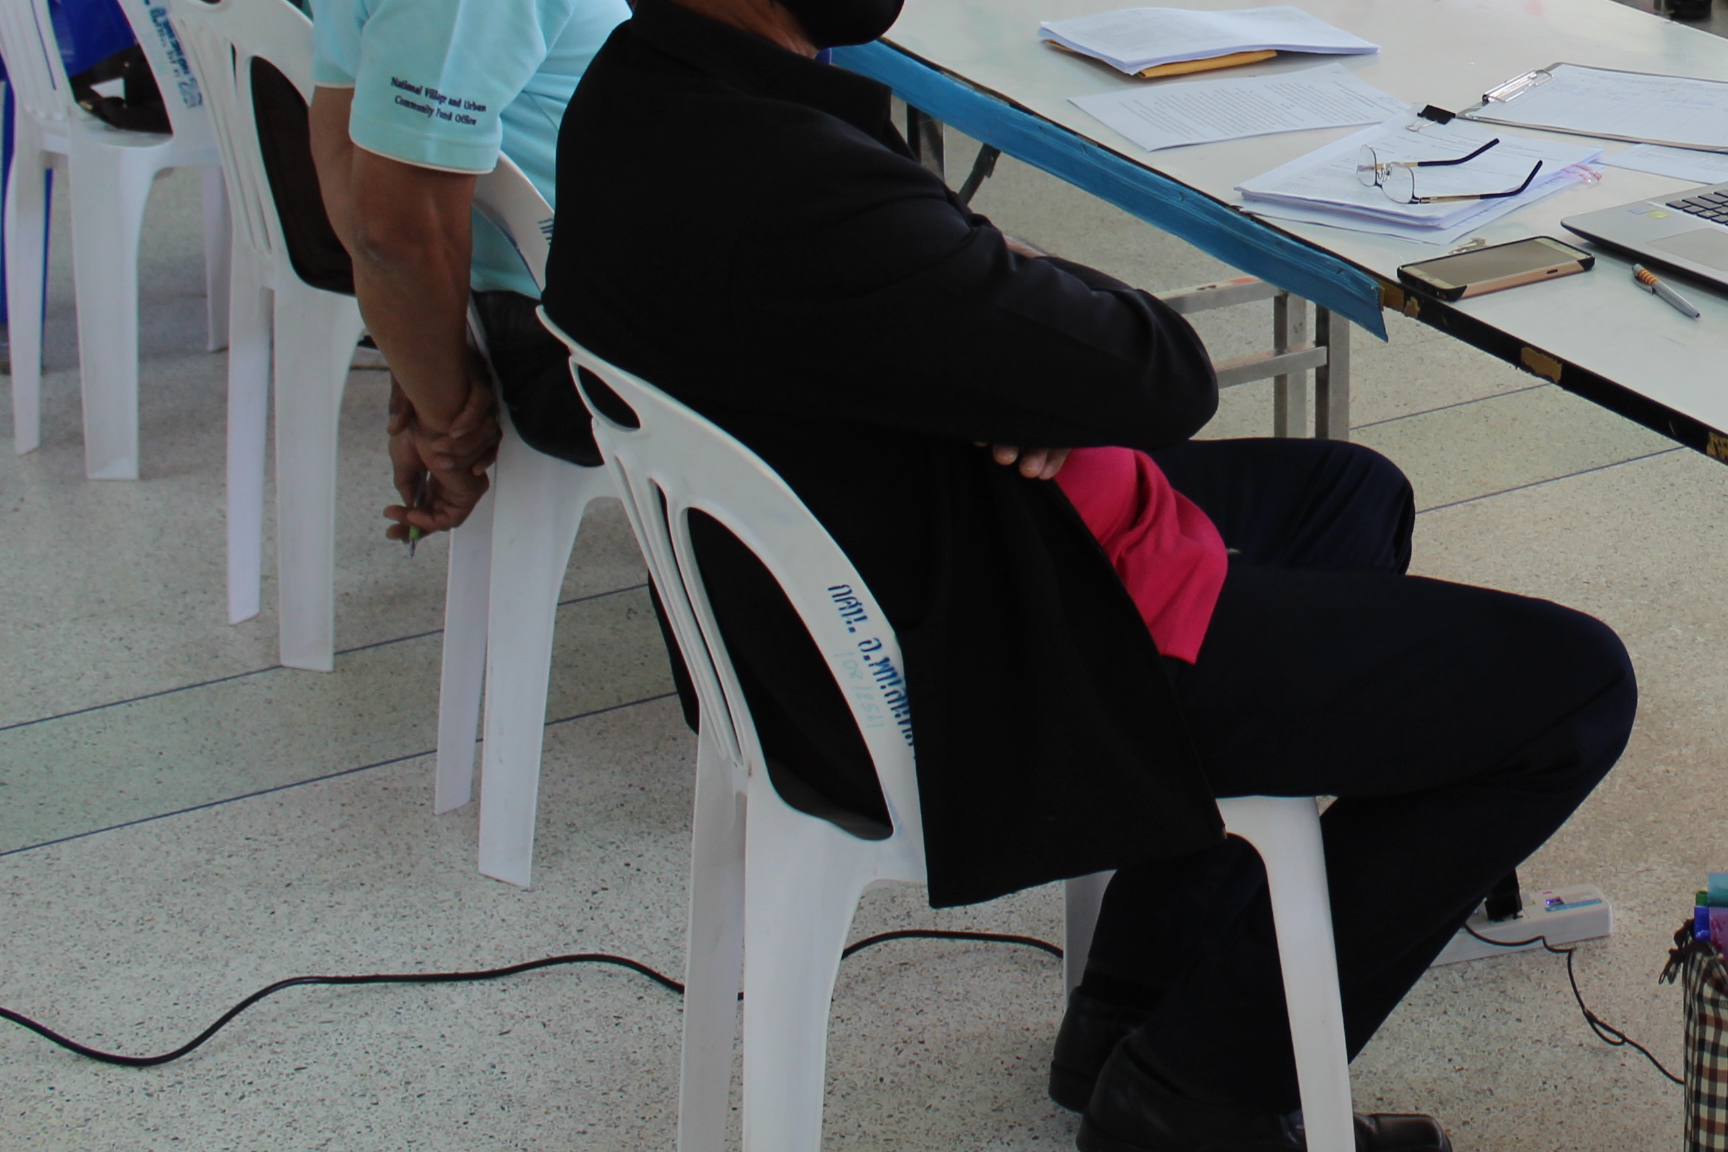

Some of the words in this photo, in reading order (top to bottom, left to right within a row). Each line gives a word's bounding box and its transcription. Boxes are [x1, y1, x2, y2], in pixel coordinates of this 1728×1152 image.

[391, 77, 423, 95] National
[424, 87, 448, 105] Village
[448, 97, 462, 108] and
[464, 100, 486, 112] Urban
[395, 95, 435, 118] Community
[436, 108, 452, 121] Fund
[454, 113, 477, 126] Office
